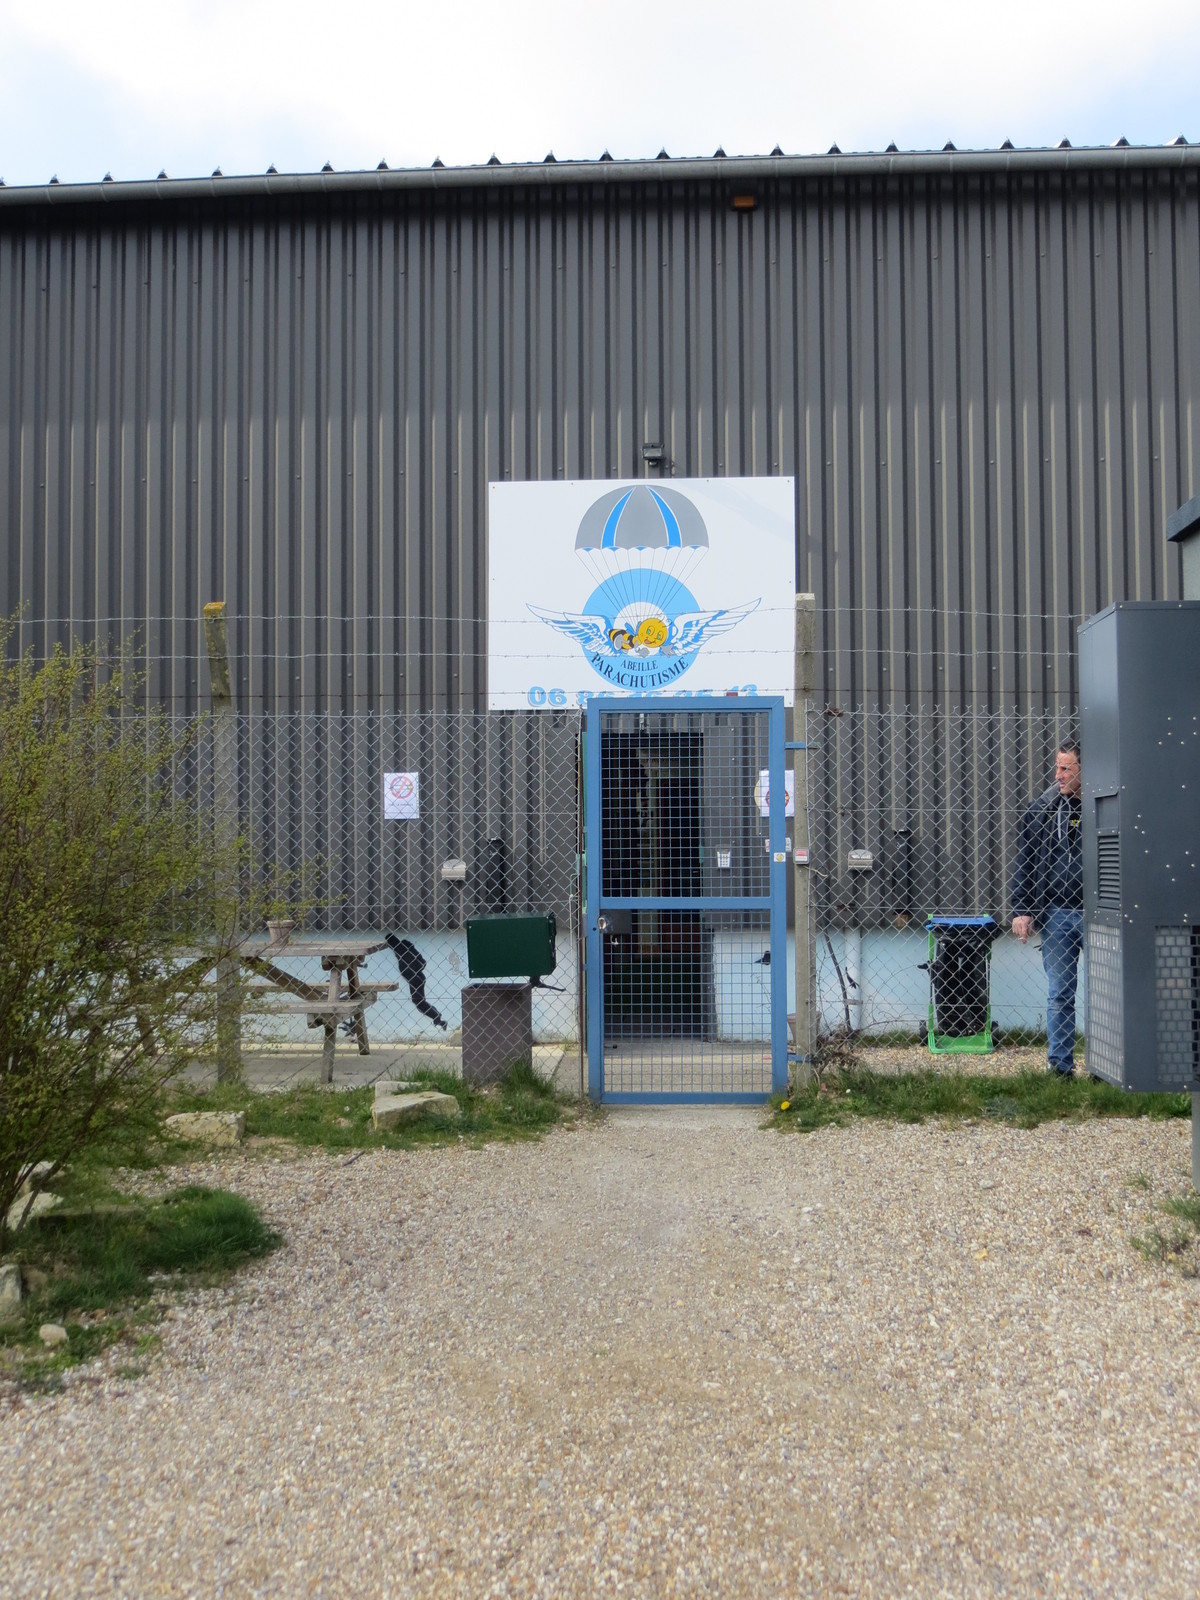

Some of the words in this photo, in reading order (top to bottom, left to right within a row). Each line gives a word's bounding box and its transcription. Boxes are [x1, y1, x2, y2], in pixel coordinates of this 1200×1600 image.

[591, 652, 689, 688] PARACHUTISME
[620, 659, 658, 672] ABEILLE
[528, 686, 567, 706] 06
